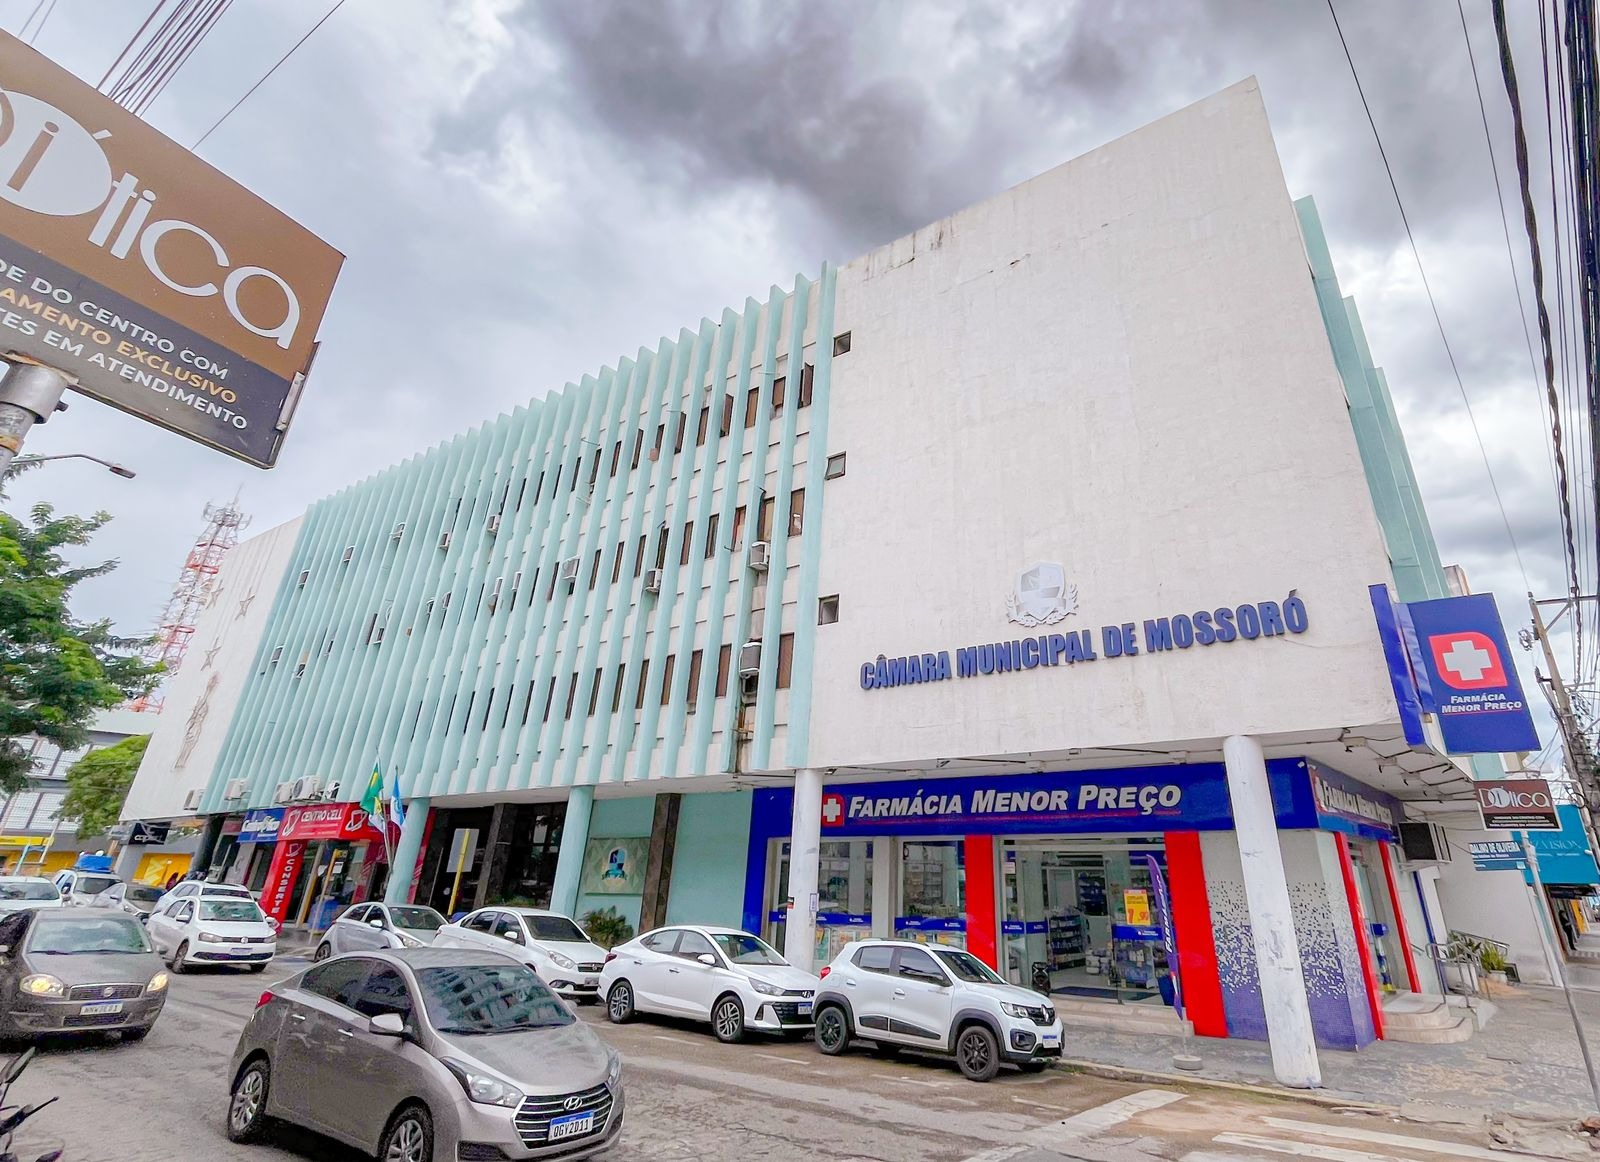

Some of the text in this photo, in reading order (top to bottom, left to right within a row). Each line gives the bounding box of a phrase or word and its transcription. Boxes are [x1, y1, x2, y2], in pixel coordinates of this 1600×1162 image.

[30, 277, 73, 304] DO
[79, 300, 175, 353] CENTRO
[179, 348, 230, 380] COM
[43, 330, 84, 356] EM
[88, 352, 248, 429] ATENDIMENTO
[117, 340, 237, 403] EXCLUSIVO
[860, 588, 1309, 690] CÂMARA MUNICIPAL DE MOSSORÓ
[1441, 701, 1522, 714] MENOR PREÇO
[1450, 692, 1506, 704] FARMÁCIA
[848, 785, 1182, 818] FARMÁCIA MENOR PREÇO
